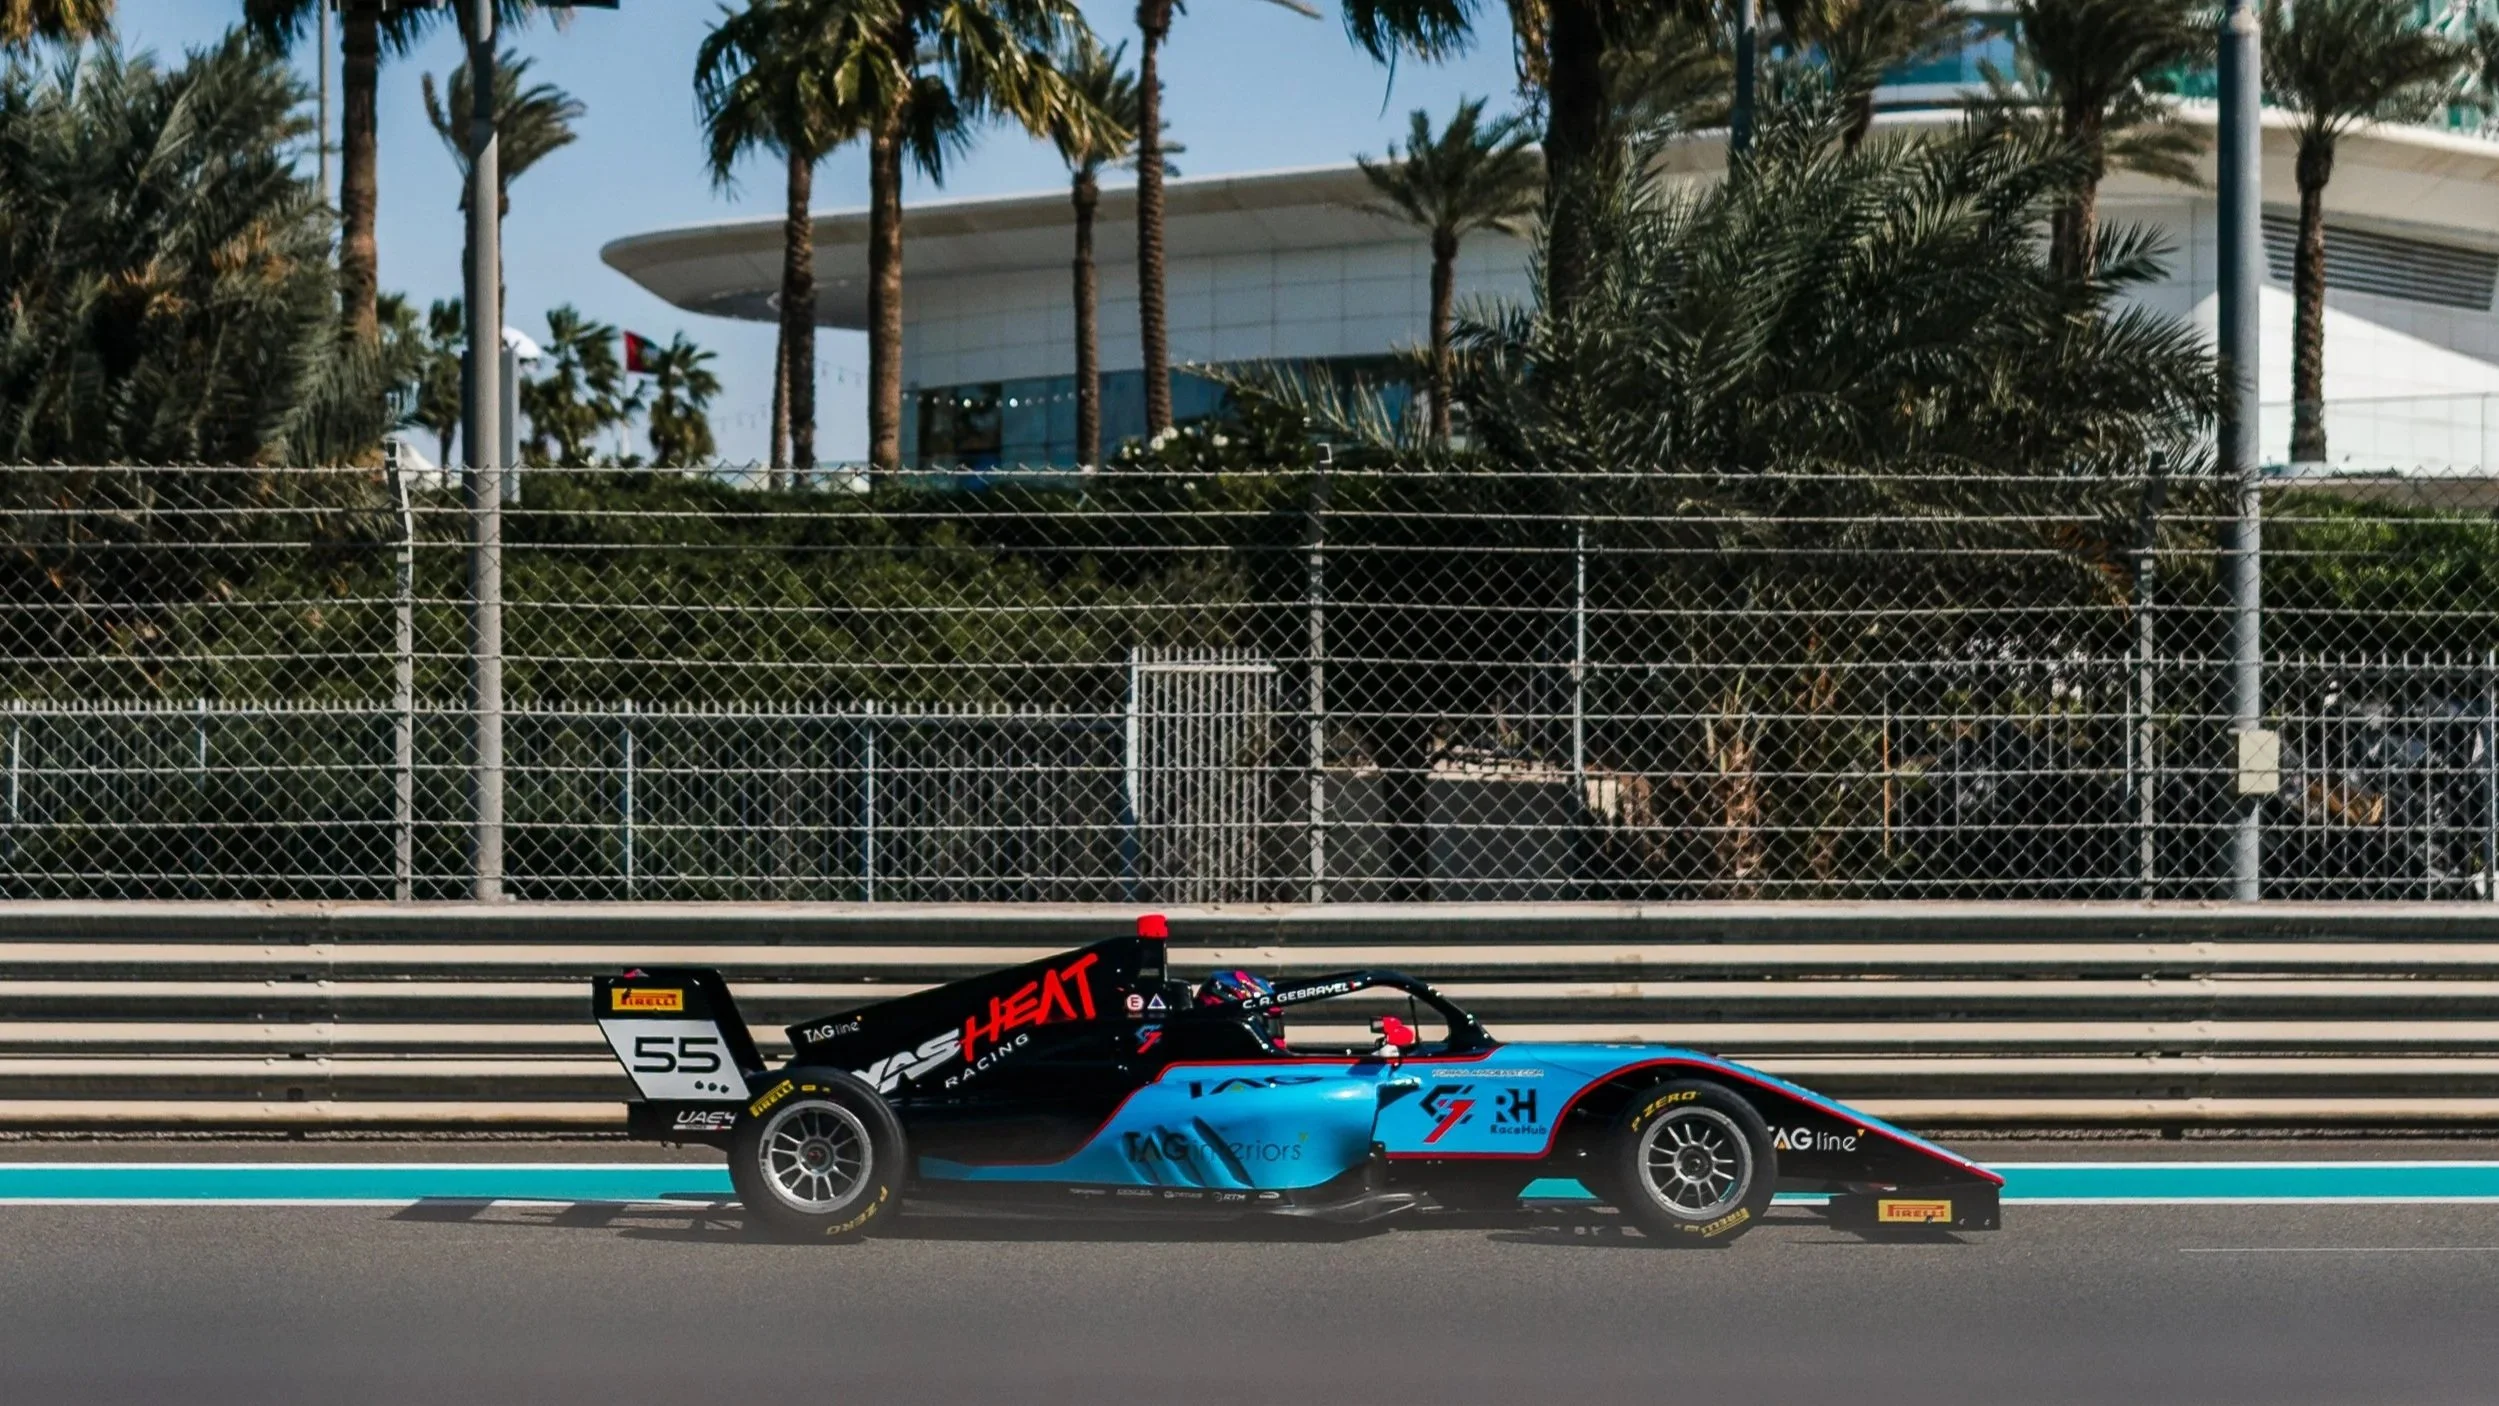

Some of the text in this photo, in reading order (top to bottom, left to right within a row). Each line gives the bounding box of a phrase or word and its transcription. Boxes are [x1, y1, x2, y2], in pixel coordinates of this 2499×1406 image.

[621, 993, 677, 1006] PIRELLI
[1276, 982, 1349, 1003] GEBRAYEL
[633, 1036, 721, 1073] 55
[944, 1033, 1030, 1088] RACING
[749, 1079, 795, 1118] PIRELLI
[1643, 1091, 1697, 1117] ZERO
[676, 1110, 738, 1125] UAE4
[1490, 1125, 1547, 1136] RaceHub
[826, 1202, 878, 1236] ZERO
[1887, 1204, 1945, 1217] PIRELLI
